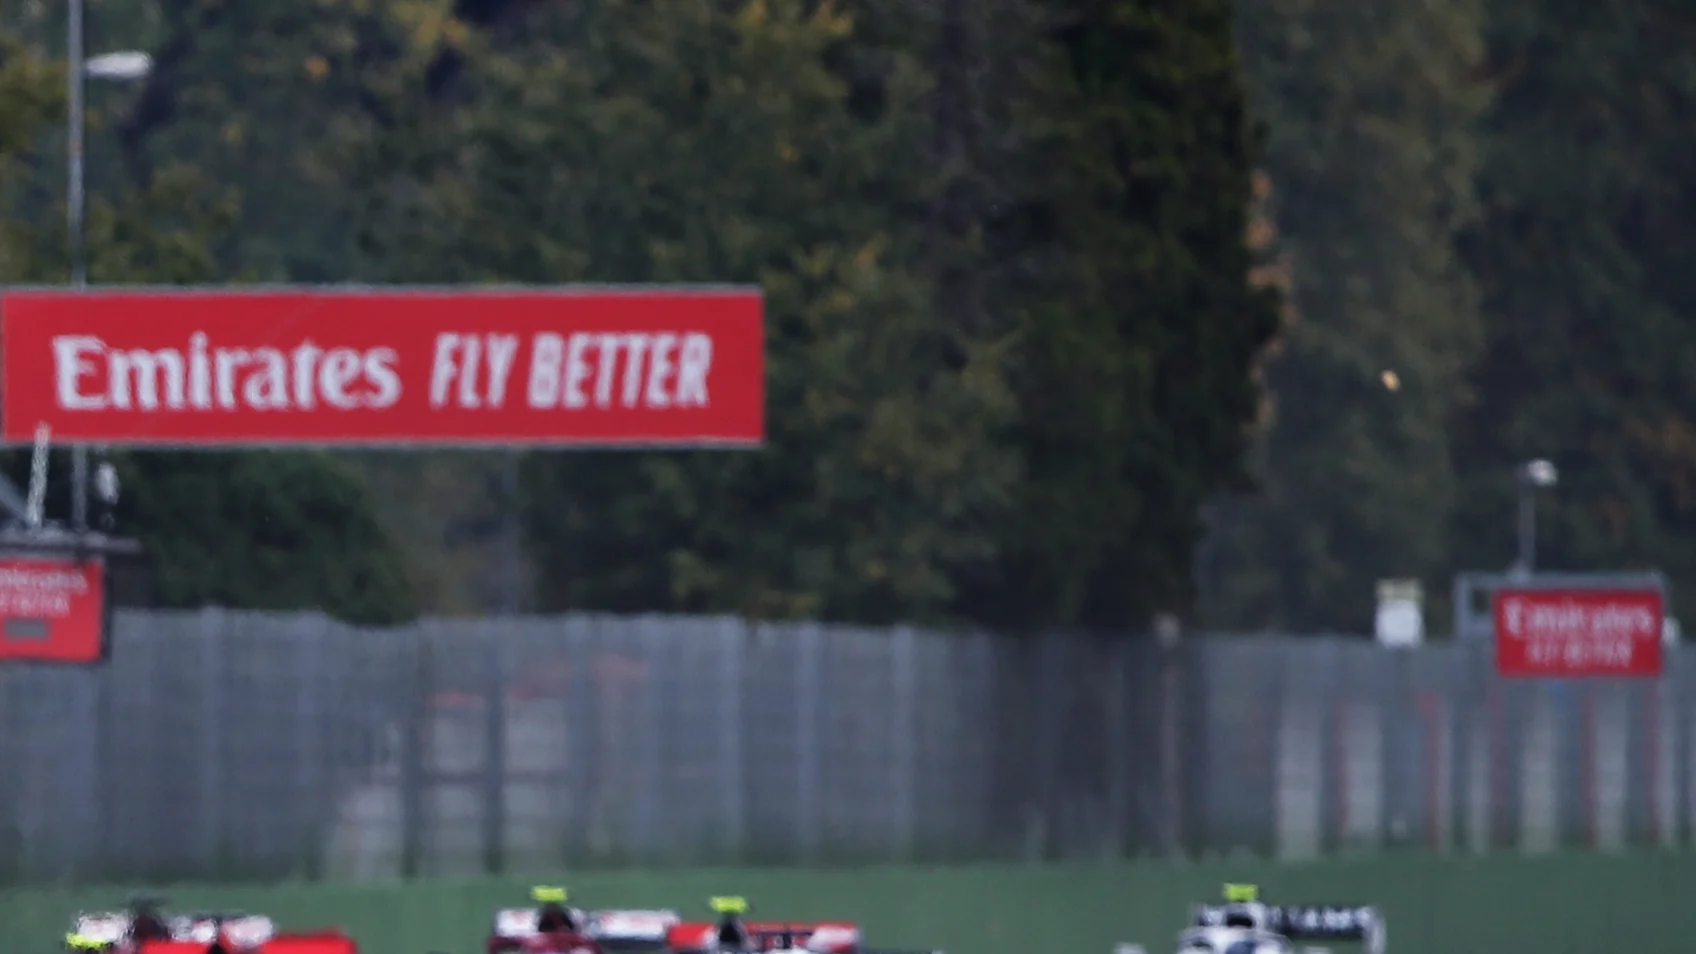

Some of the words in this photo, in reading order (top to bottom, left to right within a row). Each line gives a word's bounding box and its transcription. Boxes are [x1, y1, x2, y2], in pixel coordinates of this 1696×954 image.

[53, 332, 402, 412] Emirates
[430, 333, 518, 408] FLY
[528, 333, 713, 408] BETTER
